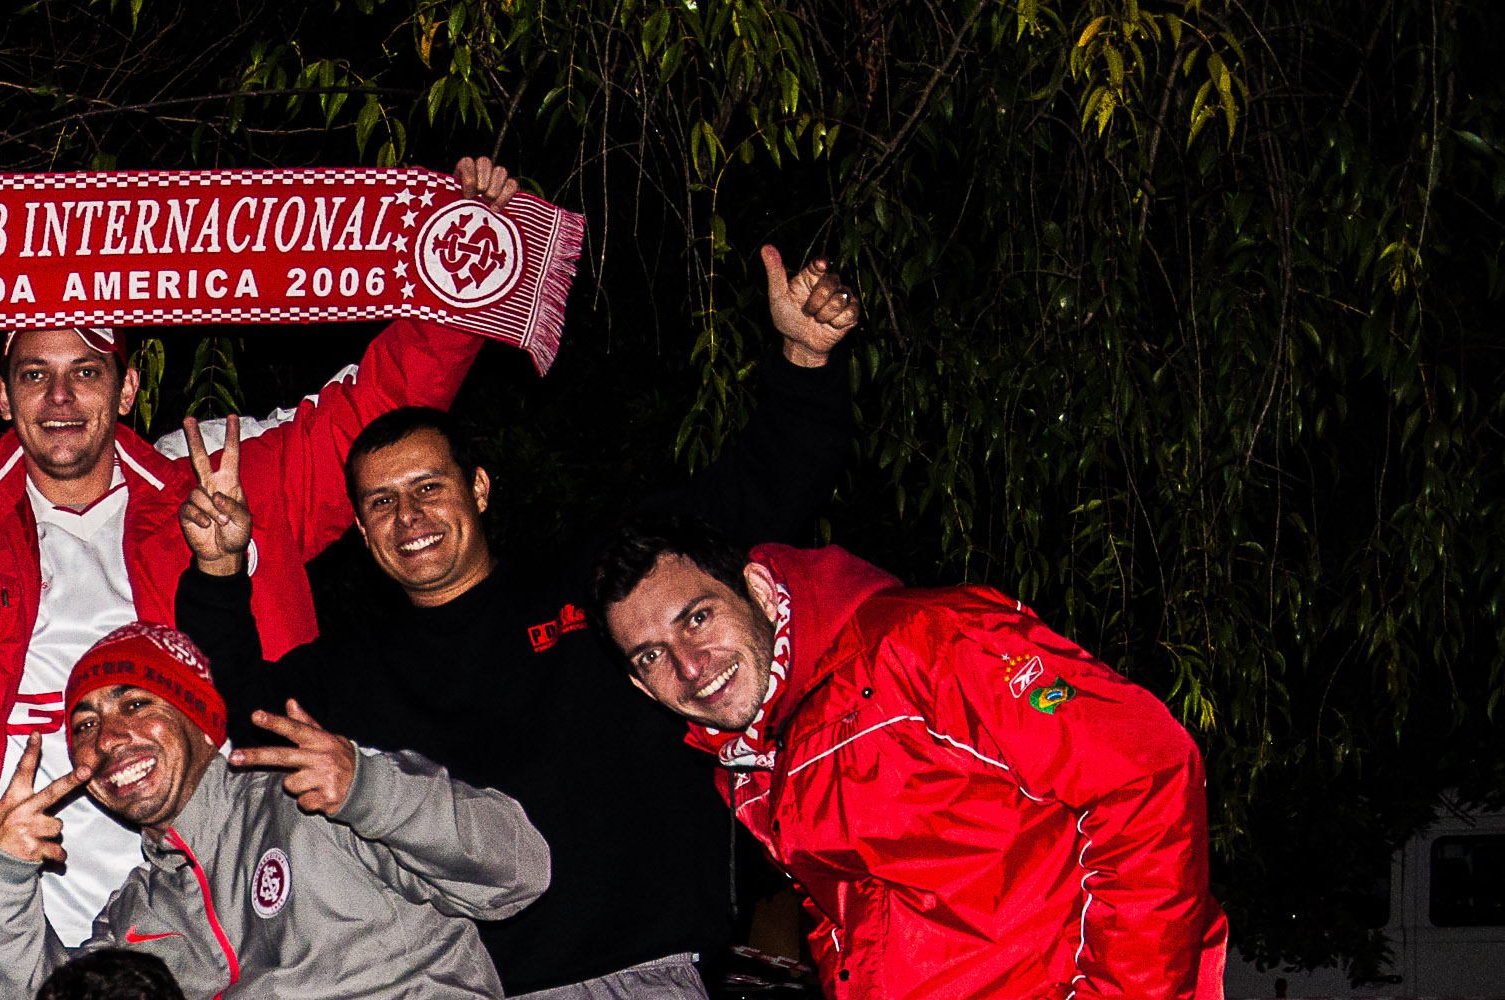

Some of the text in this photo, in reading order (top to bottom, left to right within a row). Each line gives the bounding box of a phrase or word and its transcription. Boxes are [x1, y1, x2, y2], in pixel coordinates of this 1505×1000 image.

[19, 196, 396, 258] INTERNACIONAL
[62, 269, 259, 301] AMERICA
[286, 267, 386, 298] 2006
